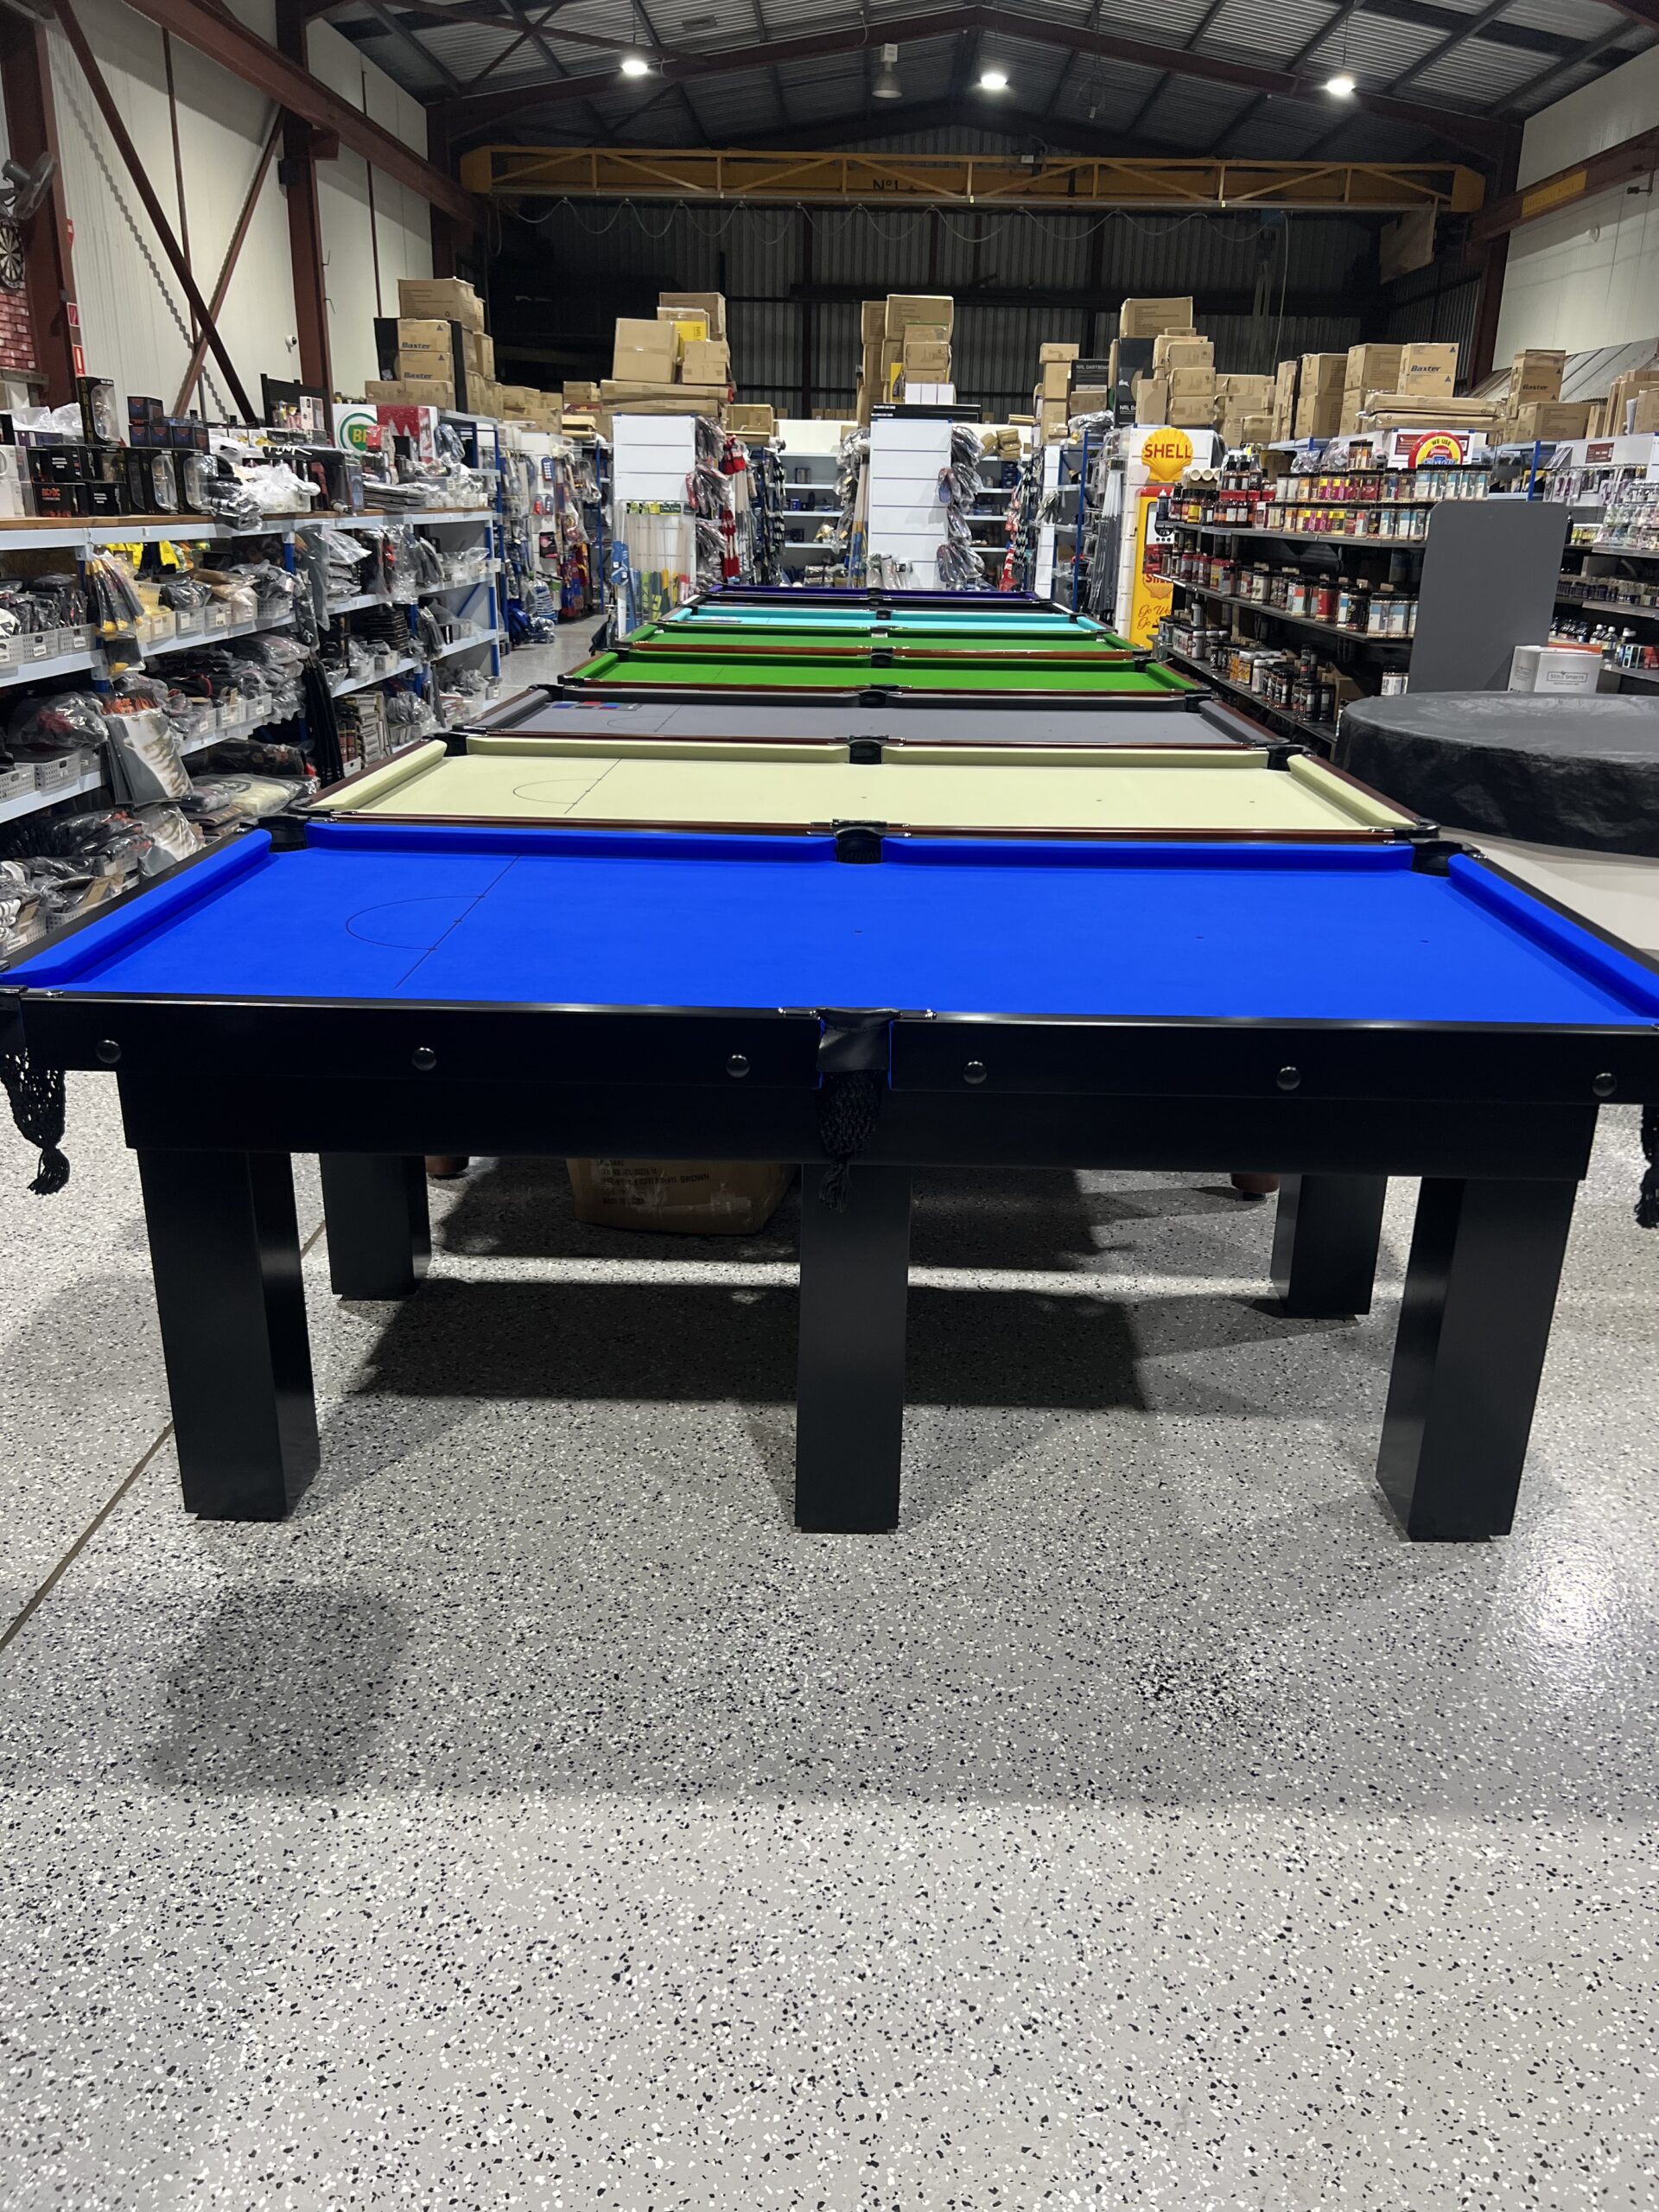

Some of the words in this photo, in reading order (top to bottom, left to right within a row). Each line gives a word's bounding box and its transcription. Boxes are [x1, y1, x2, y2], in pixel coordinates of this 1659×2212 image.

[401, 341, 431, 350] Baxter
[404, 372, 433, 380] Baxter
[1441, 438, 1452, 447] USE
[1144, 443, 1192, 459] SHELL
[1137, 604, 1153, 618] Go
[1136, 616, 1152, 630] Go
[680, 1173, 710, 1183] BROWN
